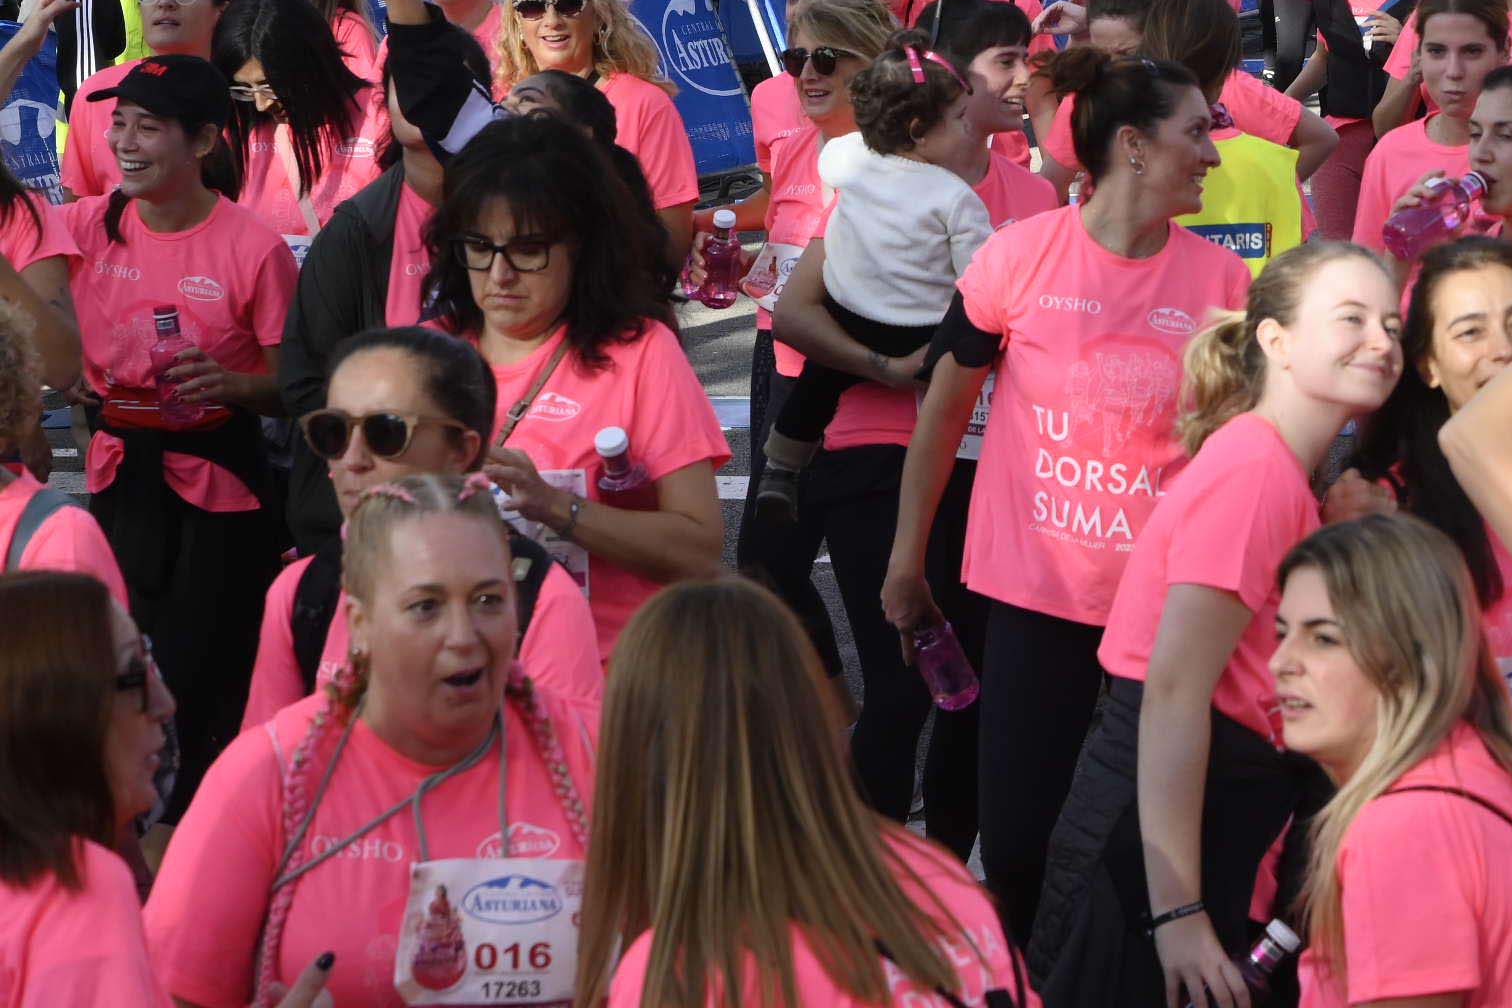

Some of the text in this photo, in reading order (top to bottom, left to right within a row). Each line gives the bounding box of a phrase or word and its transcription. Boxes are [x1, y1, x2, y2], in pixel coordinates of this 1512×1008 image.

[1038, 293, 1102, 315] OYSHO
[1031, 403, 1070, 442] TU
[1034, 447, 1167, 497] DORSAL
[1032, 490, 1134, 540] SUMA
[471, 894, 558, 913] ASTURIANA
[473, 941, 554, 971] 016
[481, 979, 542, 1000] 17263
